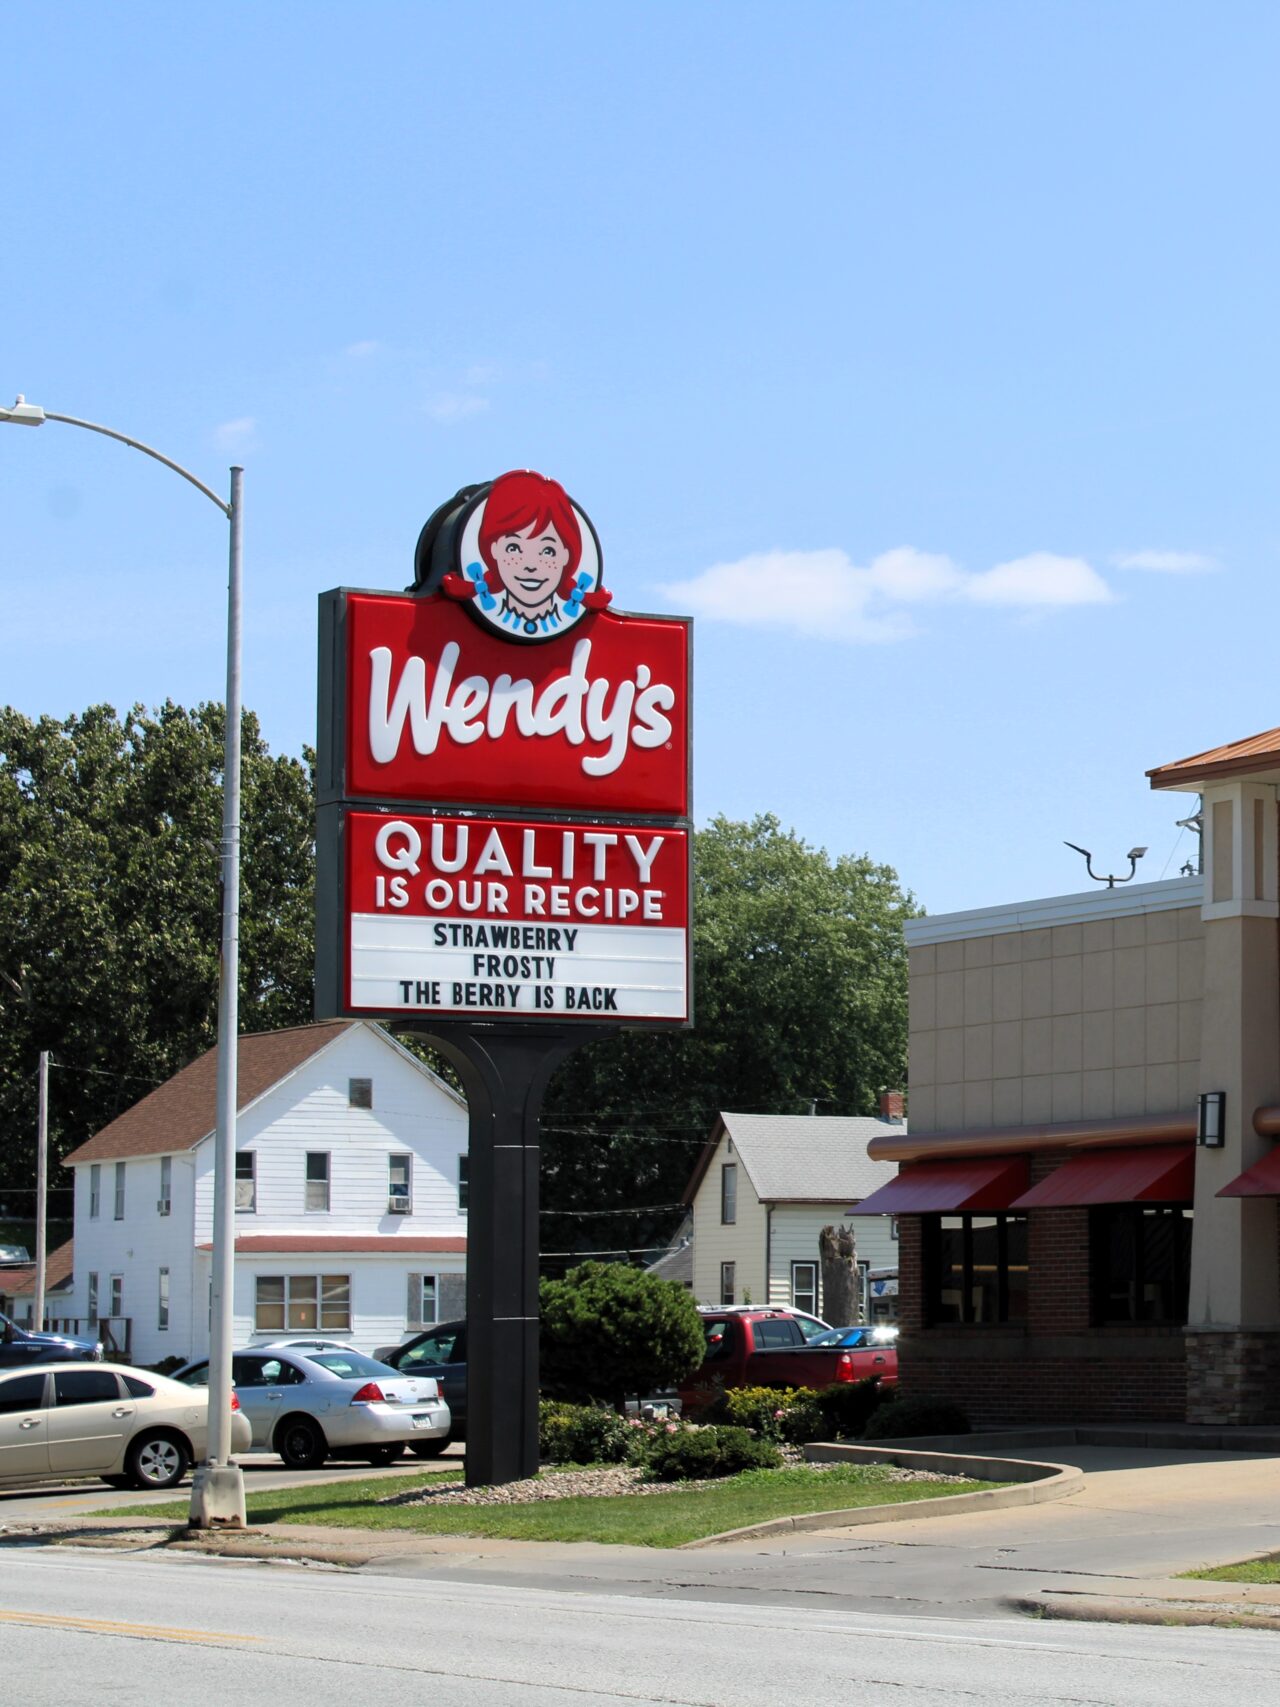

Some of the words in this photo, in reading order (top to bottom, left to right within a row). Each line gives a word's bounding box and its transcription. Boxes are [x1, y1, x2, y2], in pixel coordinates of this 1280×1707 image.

[369, 638, 675, 777] Wendy's
[375, 820, 665, 884] QUALITY
[375, 875, 410, 909] IS
[424, 878, 509, 914] OUR
[524, 884, 664, 921] RECIPE
[434, 922, 579, 952] STRAWBERRY
[472, 954, 556, 980] FROSTY
[399, 980, 441, 1006] THE
[453, 982, 521, 1008] BERRY
[535, 985, 554, 1009] IS
[565, 986, 618, 1011] BACK
